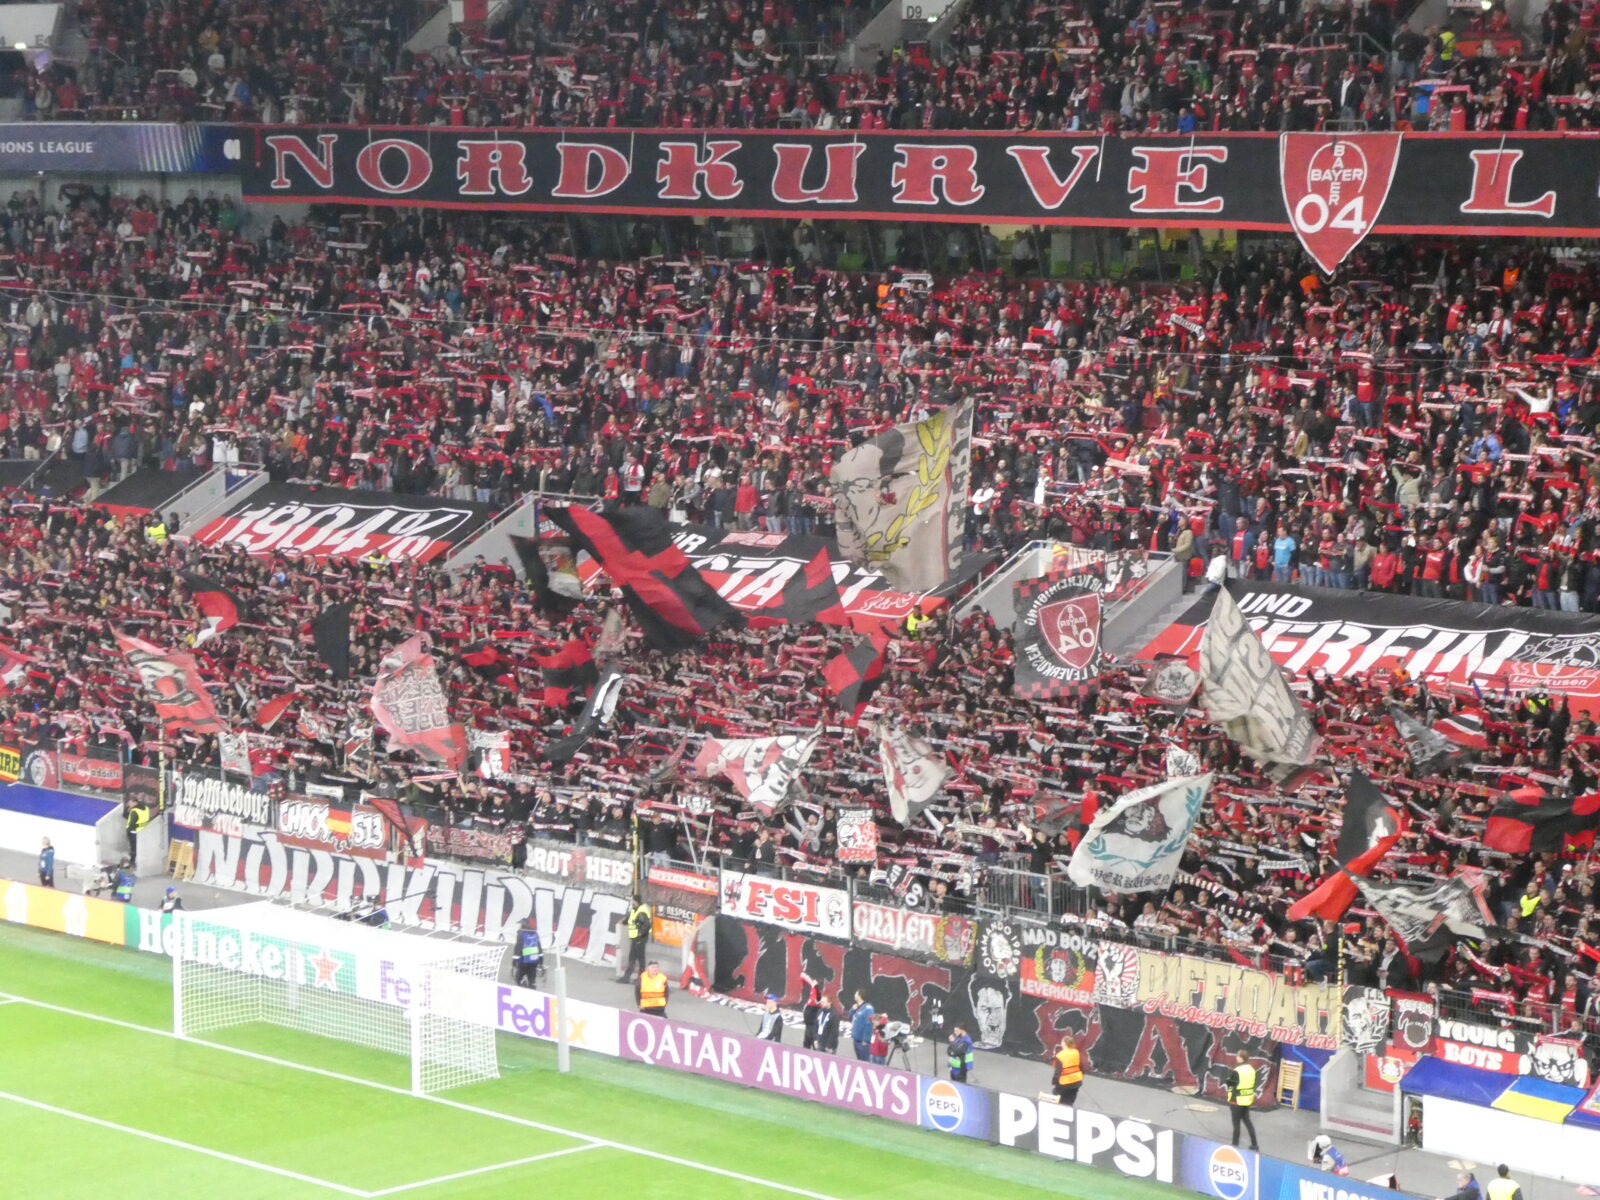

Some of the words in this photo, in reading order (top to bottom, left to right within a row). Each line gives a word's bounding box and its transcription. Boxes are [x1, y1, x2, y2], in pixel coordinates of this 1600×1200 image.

[906, 6, 922, 18] D9
[39, 141, 93, 154] LEAGUE
[265, 131, 1229, 215] NORDKURVE
[1310, 168, 1364, 182] BAYER
[1295, 193, 1367, 235] 04
[1238, 592, 1313, 618] UND
[666, 905, 696, 921] RESPECT
[746, 880, 820, 927] FSI
[1022, 927, 1058, 947] MAD
[1438, 1019, 1516, 1052] YOUNG
[627, 1018, 743, 1078] QATAR
[756, 1046, 911, 1115] AIRWAYS
[1444, 1042, 1503, 1071] BOYS
[929, 1098, 961, 1114] PEPSI
[999, 1092, 1174, 1184] PEPSI
[1212, 1164, 1245, 1182] PEPSI
